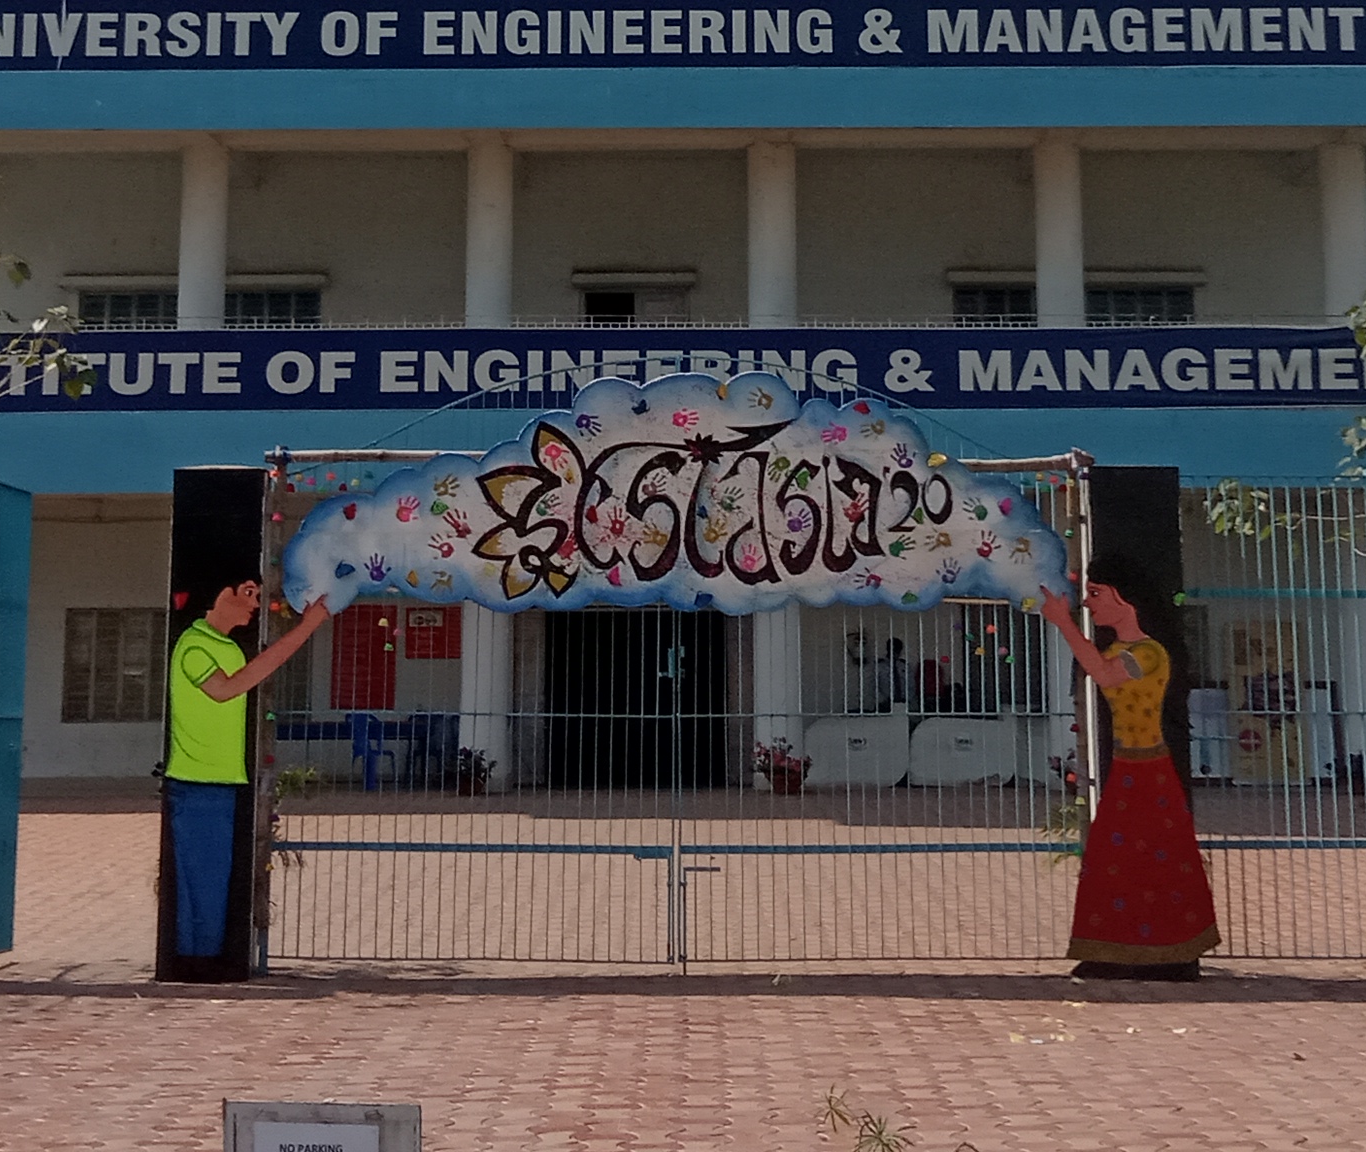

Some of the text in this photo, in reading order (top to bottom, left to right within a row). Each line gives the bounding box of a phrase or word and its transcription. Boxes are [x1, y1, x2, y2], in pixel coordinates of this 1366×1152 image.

[320, 11, 399, 57] OF
[422, 8, 834, 57] ENGINEERING
[858, 8, 904, 54] &
[927, 6, 1366, 54] MANAGEMENT
[259, 351, 358, 394] OF
[378, 348, 859, 394] ENGINEERING
[887, 349, 935, 393] &
[279, 1143, 344, 1152] NO PARKING
